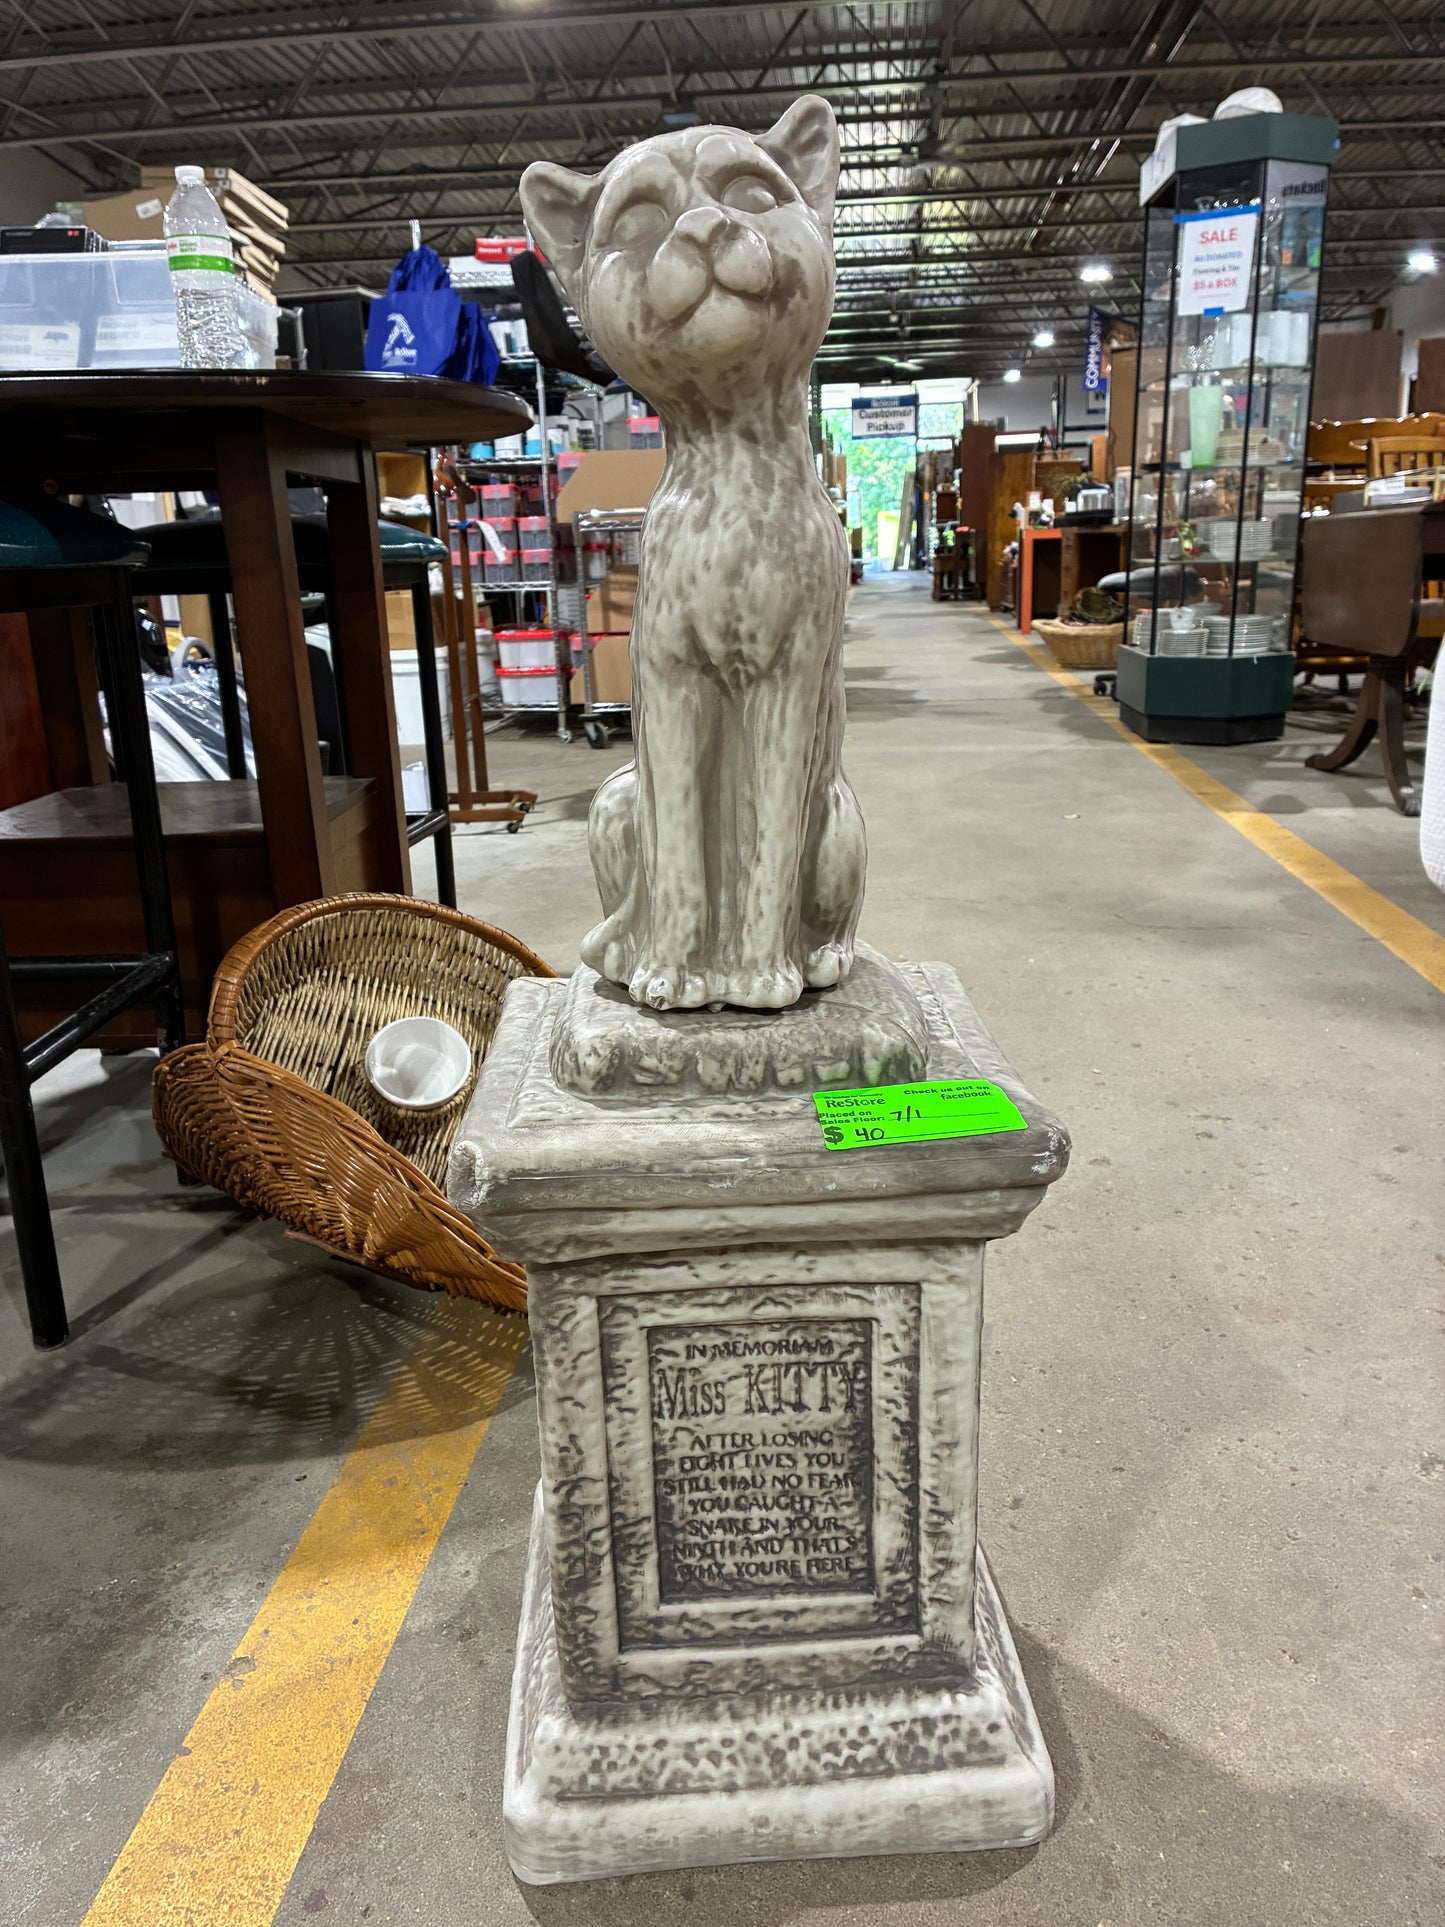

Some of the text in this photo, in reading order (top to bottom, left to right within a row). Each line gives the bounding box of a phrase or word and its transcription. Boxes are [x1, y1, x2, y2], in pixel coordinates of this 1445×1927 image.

[1200, 227, 1238, 245] SALE
[1085, 309, 1101, 389] COMMUNITY
[858, 408, 912, 420] Customer
[866, 421, 905, 432] Pickup
[826, 1098, 885, 1109] ReStore
[940, 1091, 991, 1100] facebook
[819, 1110, 855, 1119] Placed
[821, 1118, 851, 1126] Sales
[824, 1126, 845, 1146] $
[854, 1126, 885, 1141] 40
[743, 1361, 866, 1416] KITTY
[690, 1430, 833, 1450] AFTER LOSING
[680, 1452, 846, 1474] EIGHT LIVES YOU
[663, 1473, 856, 1497] STILL HAD NO FEAR
[688, 1497, 731, 1515] YOU
[734, 1494, 816, 1514] CAUGHT
[688, 1516, 844, 1540] SNAKE IN YOUR
[740, 1537, 784, 1559] AND
[806, 1556, 857, 1574] HERE
